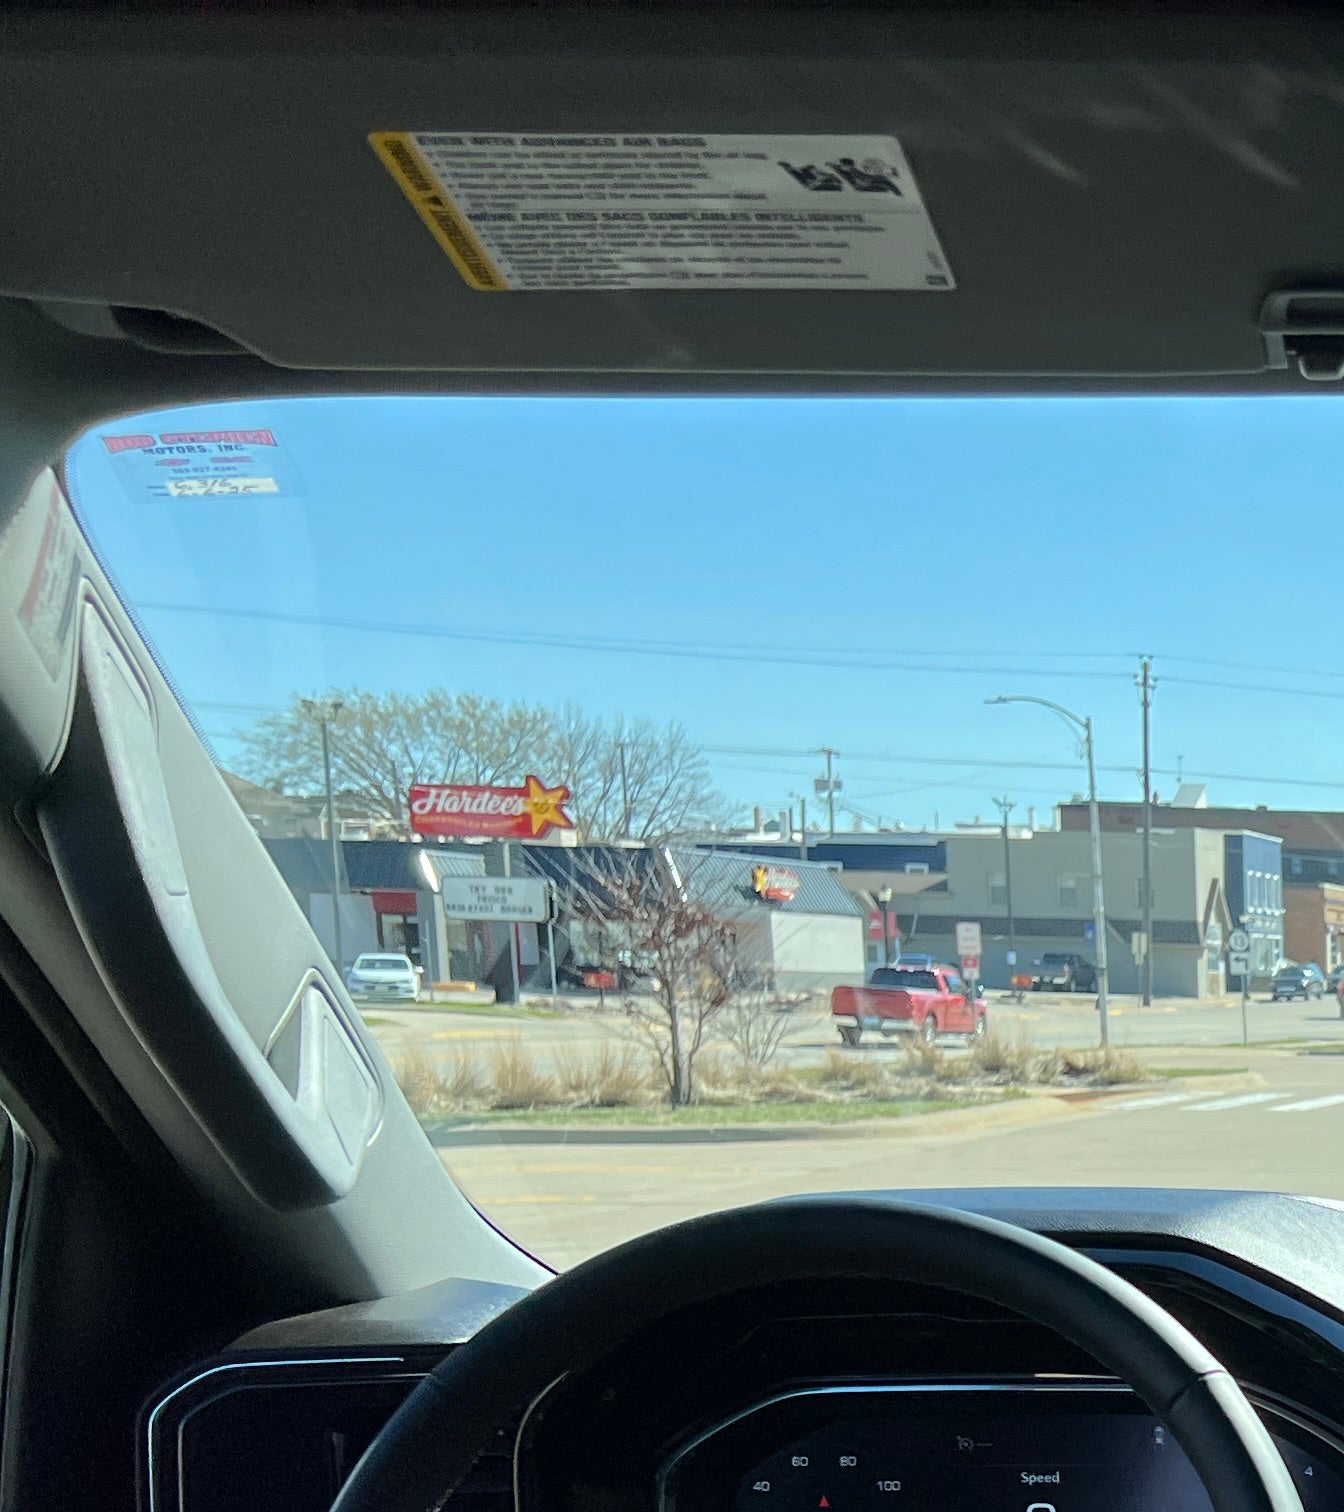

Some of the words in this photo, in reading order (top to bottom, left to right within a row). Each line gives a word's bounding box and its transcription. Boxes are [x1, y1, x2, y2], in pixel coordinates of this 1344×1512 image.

[791, 1455, 809, 1467] 60
[839, 1455, 857, 1467] 80
[1303, 1466, 1313, 1477] 4
[1020, 1471, 1060, 1488] Speed
[752, 1481, 770, 1492] 40
[876, 1480, 901, 1491] 100
